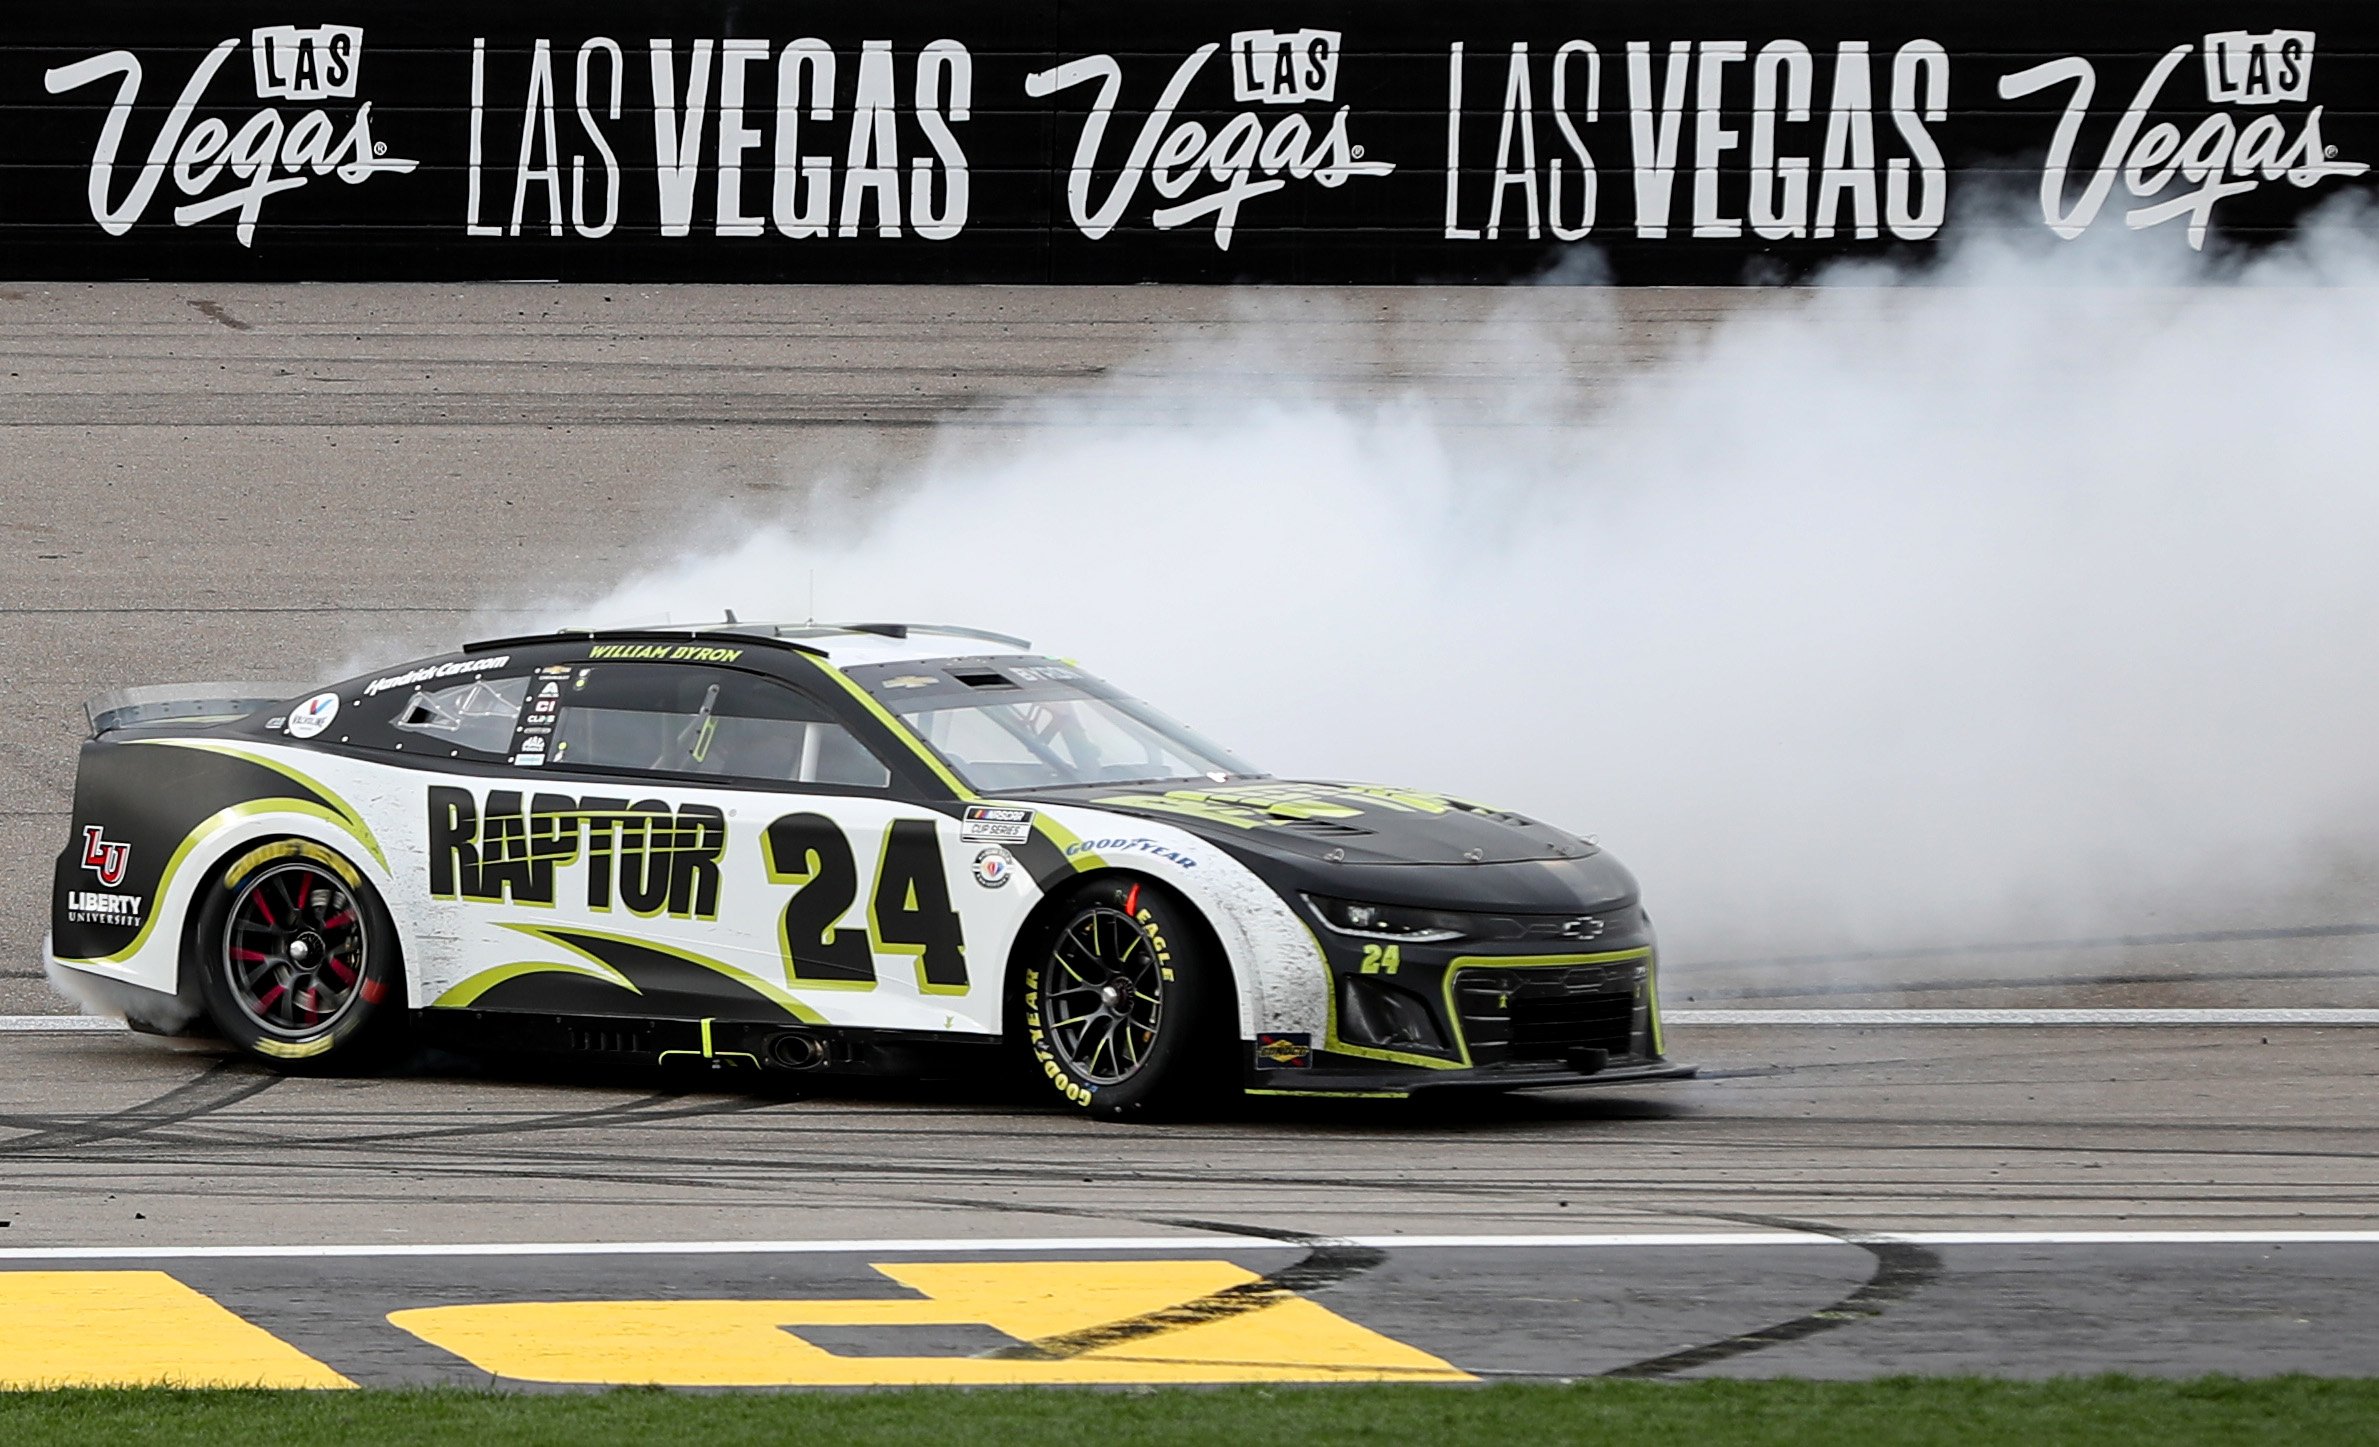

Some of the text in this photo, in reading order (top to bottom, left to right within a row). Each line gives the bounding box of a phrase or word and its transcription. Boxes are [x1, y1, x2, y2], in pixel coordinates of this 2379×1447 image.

[265, 32, 351, 91] LAS
[1245, 36, 1330, 92] LAS
[2217, 39, 2302, 93] LAS
[466, 37, 972, 241] LAS VEGAS
[1444, 39, 1950, 241] LAS VEGAS
[588, 645, 744, 663] WILLIAM BYRON
[81, 825, 132, 888] LU
[427, 785, 729, 922] RAPTOR
[971, 824, 1020, 836] CUP SERIES
[1066, 837, 1198, 870] GOODYEAR
[68, 891, 142, 915] LIBERTY
[68, 911, 142, 927] UNIVERSITY
[759, 811, 972, 996] 24
[1135, 908, 1175, 983] EAGLE
[1360, 944, 1400, 975] 24
[1025, 968, 1093, 1107] GOODYEAR
